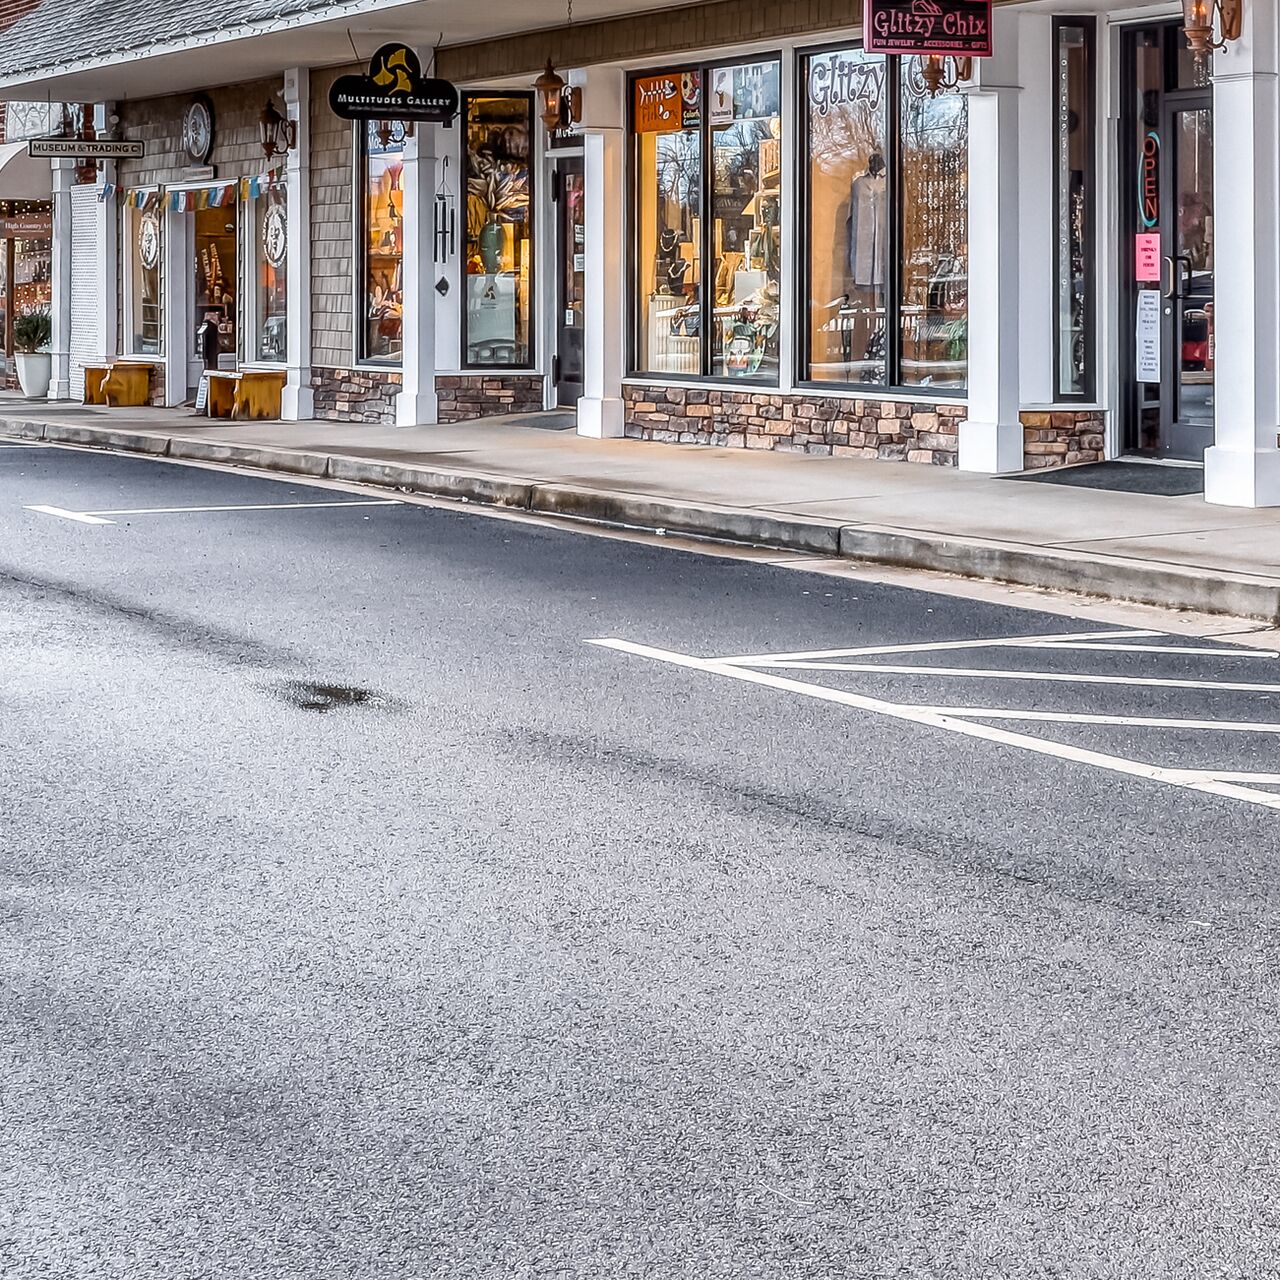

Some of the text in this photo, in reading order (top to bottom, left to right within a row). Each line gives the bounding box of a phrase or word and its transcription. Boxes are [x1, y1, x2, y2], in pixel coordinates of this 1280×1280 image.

[874, 9, 986, 37] Glitzy Chix
[873, 38, 887, 46] FUN
[887, 39, 915, 47] JEWELRY
[923, 40, 964, 48] ACCESSORIES
[808, 54, 886, 117] Glitzy
[337, 94, 451, 106] MULTITUDES GALLERY
[33, 144, 75, 152] MUSEUM
[77, 144, 86, 152] &
[86, 144, 129, 153] TRADING
[1143, 137, 1157, 219] OPEN
